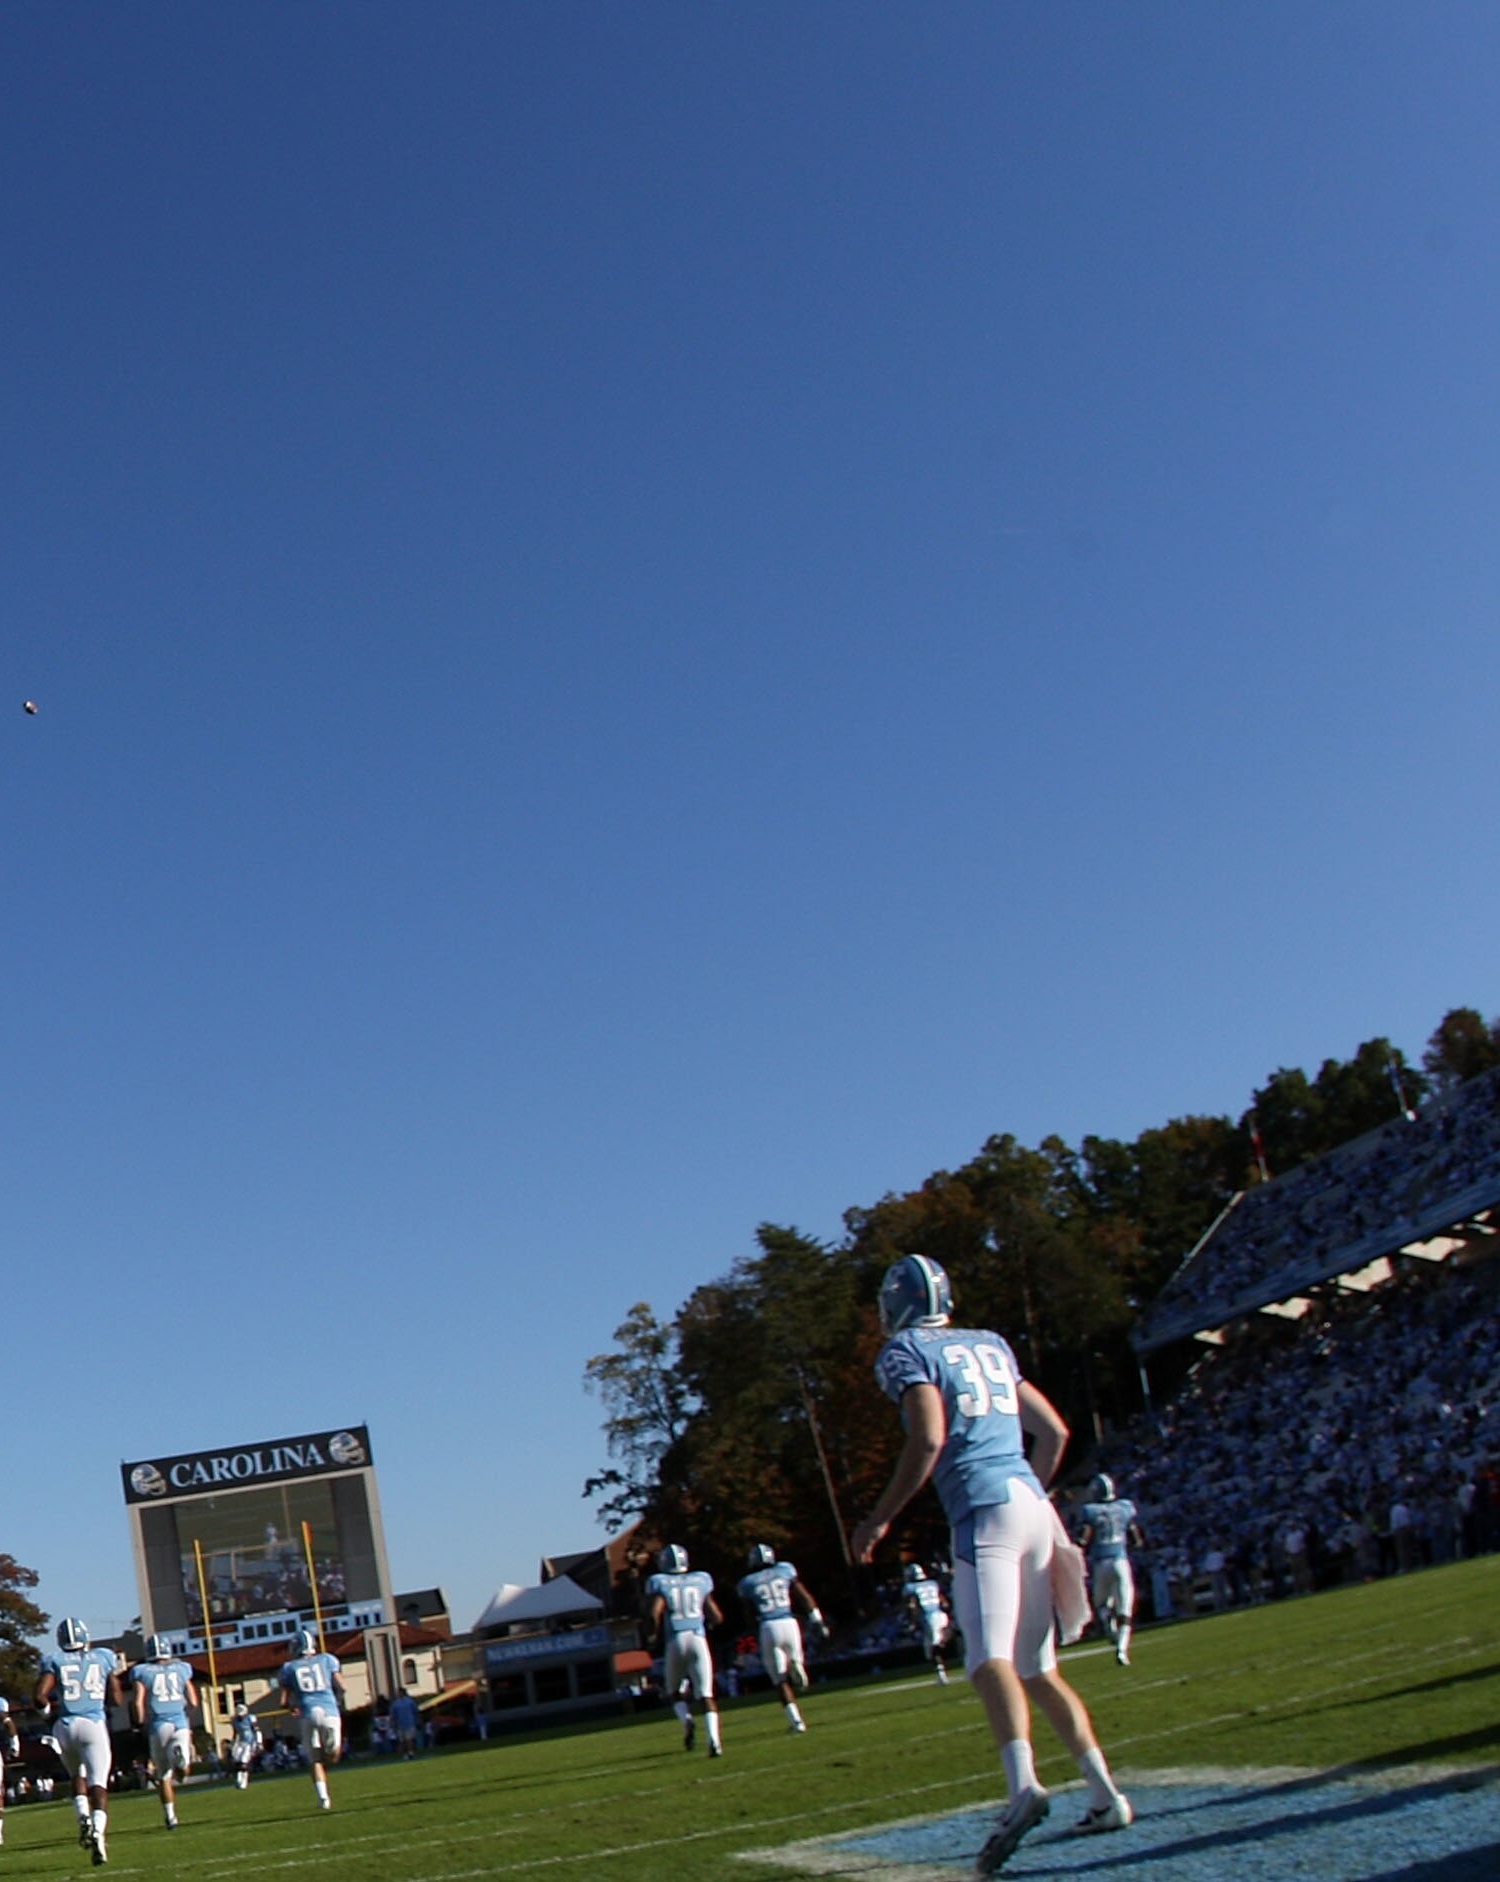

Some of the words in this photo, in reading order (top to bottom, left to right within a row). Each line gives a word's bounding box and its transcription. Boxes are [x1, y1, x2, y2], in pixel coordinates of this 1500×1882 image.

[941, 1343, 1020, 1417] 39
[169, 1443, 326, 1488] CAROLINA
[668, 1586, 702, 1620] 10
[60, 1663, 106, 1701] 54
[152, 1671, 182, 1702] 41
[295, 1663, 327, 1693] 61
